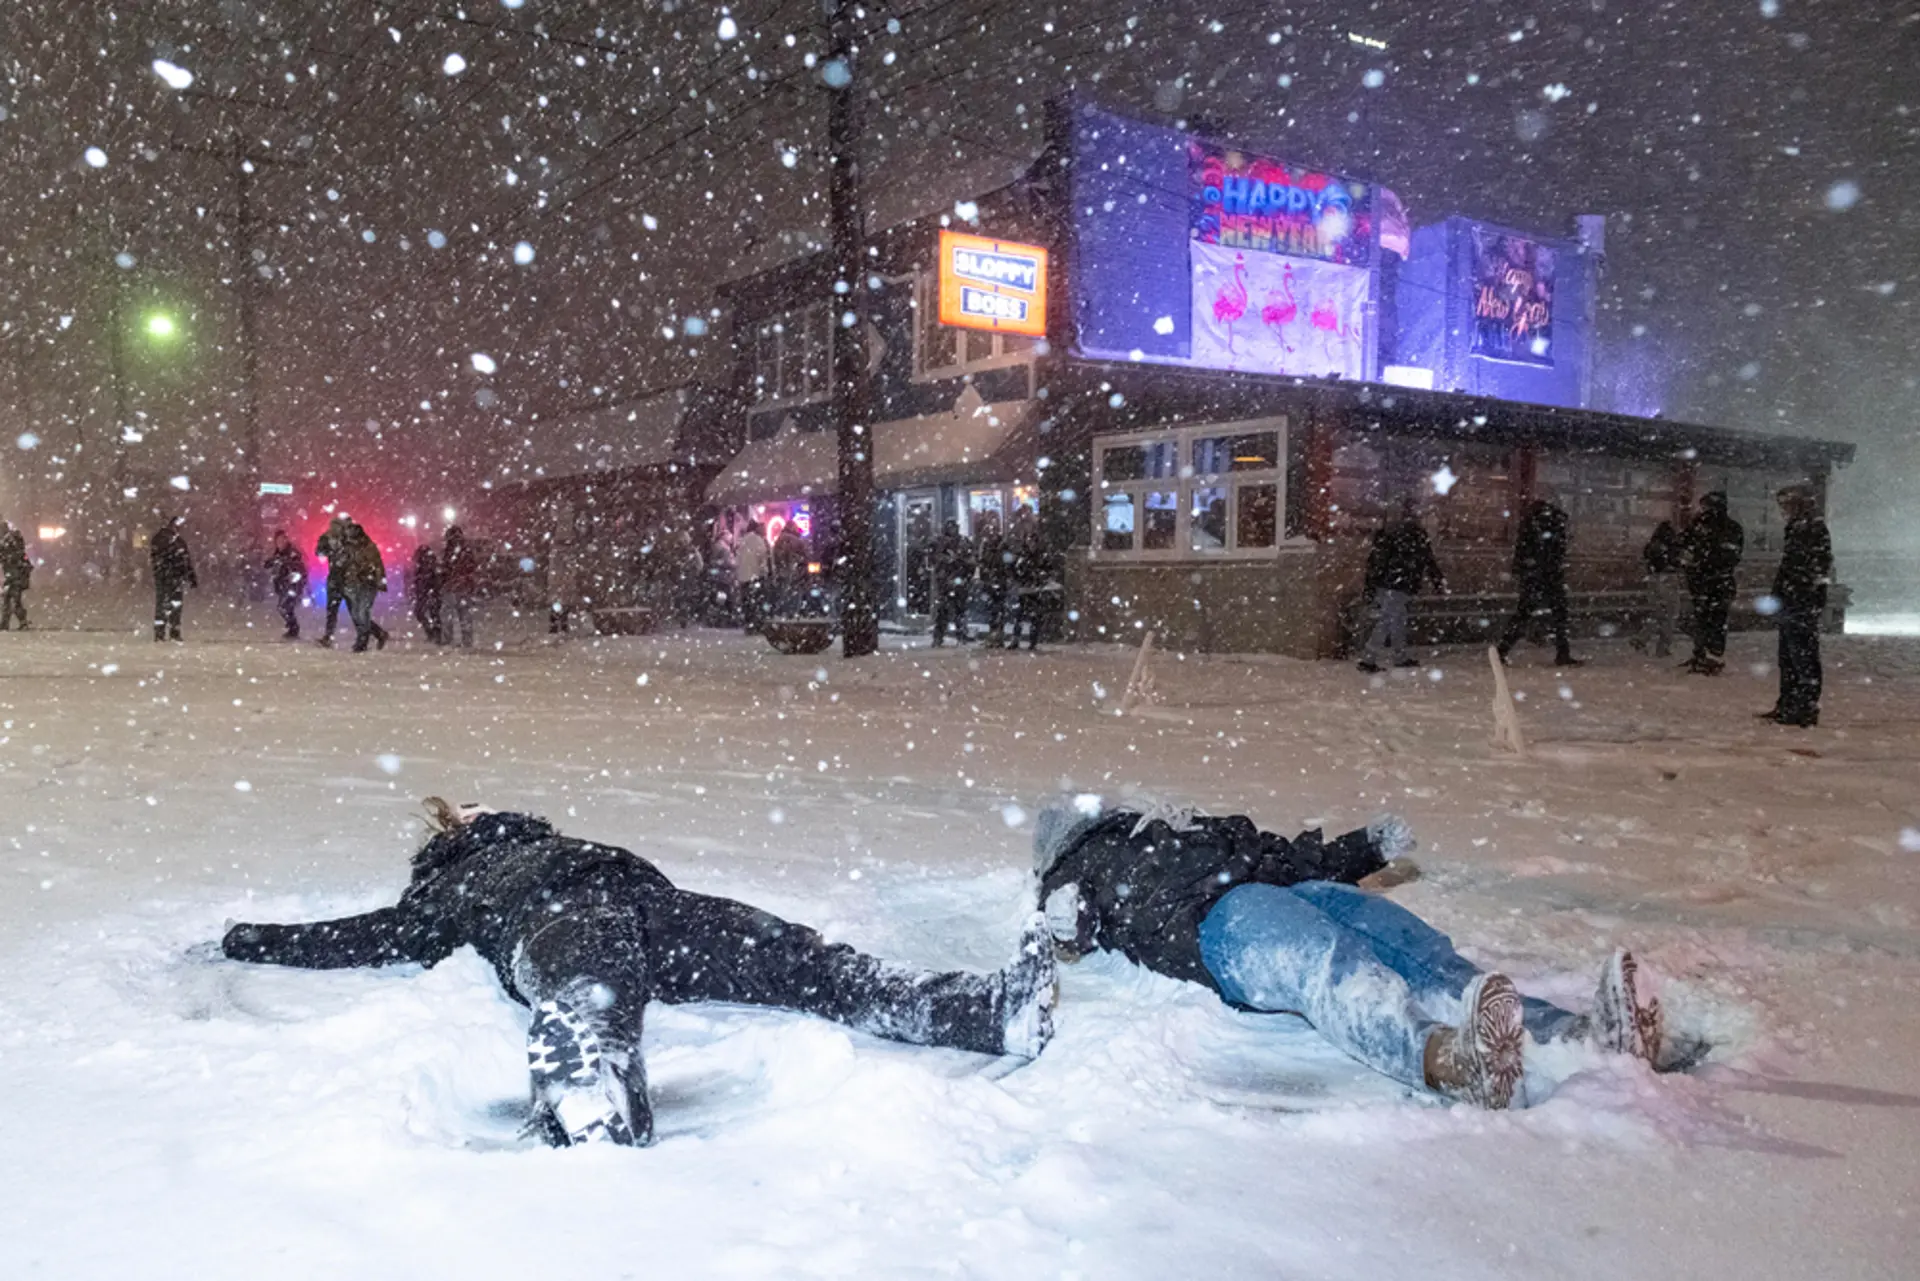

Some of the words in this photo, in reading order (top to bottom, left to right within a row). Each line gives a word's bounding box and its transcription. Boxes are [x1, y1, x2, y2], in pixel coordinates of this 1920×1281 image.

[1223, 175, 1323, 224] HAPPY
[1220, 211, 1273, 250] NEW
[957, 252, 1036, 284] SLOPPY
[968, 291, 1021, 319] BOBS
